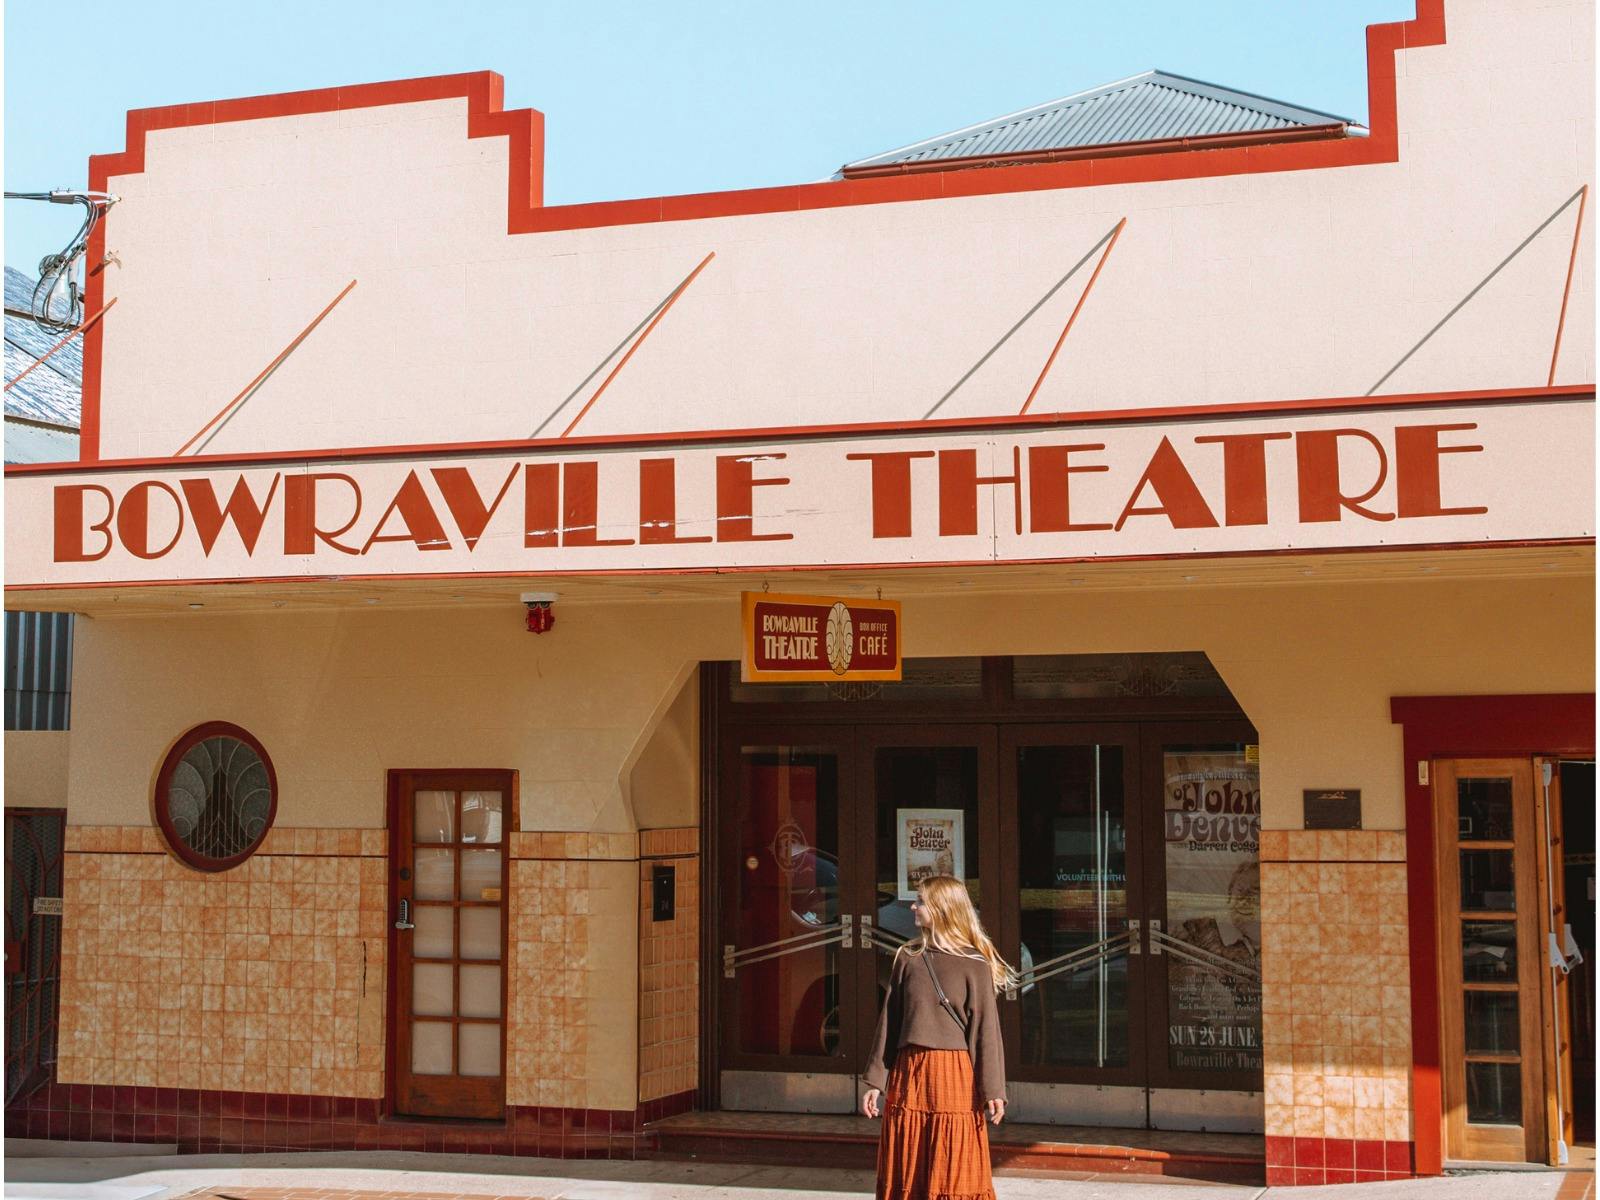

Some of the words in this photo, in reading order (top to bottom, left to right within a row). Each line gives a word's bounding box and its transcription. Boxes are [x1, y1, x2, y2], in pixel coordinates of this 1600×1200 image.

[54, 453, 794, 562] BOWRAVILLE
[846, 423, 1488, 538] THEATRE
[762, 614, 819, 634] BOWRAVILLE
[871, 622, 888, 632] OFFICE
[762, 635, 819, 660] THEATRE
[859, 633, 888, 656] CAFÉ
[914, 826, 944, 839] John
[1164, 810, 1260, 842] Denve
[910, 835, 950, 849] Denver
[1188, 840, 1228, 852] Darren
[1169, 1025, 1197, 1046] SUN
[1199, 1025, 1216, 1046] 28
[1176, 1051, 1234, 1069] Bowraville
[1237, 1052, 1262, 1070] Thea
